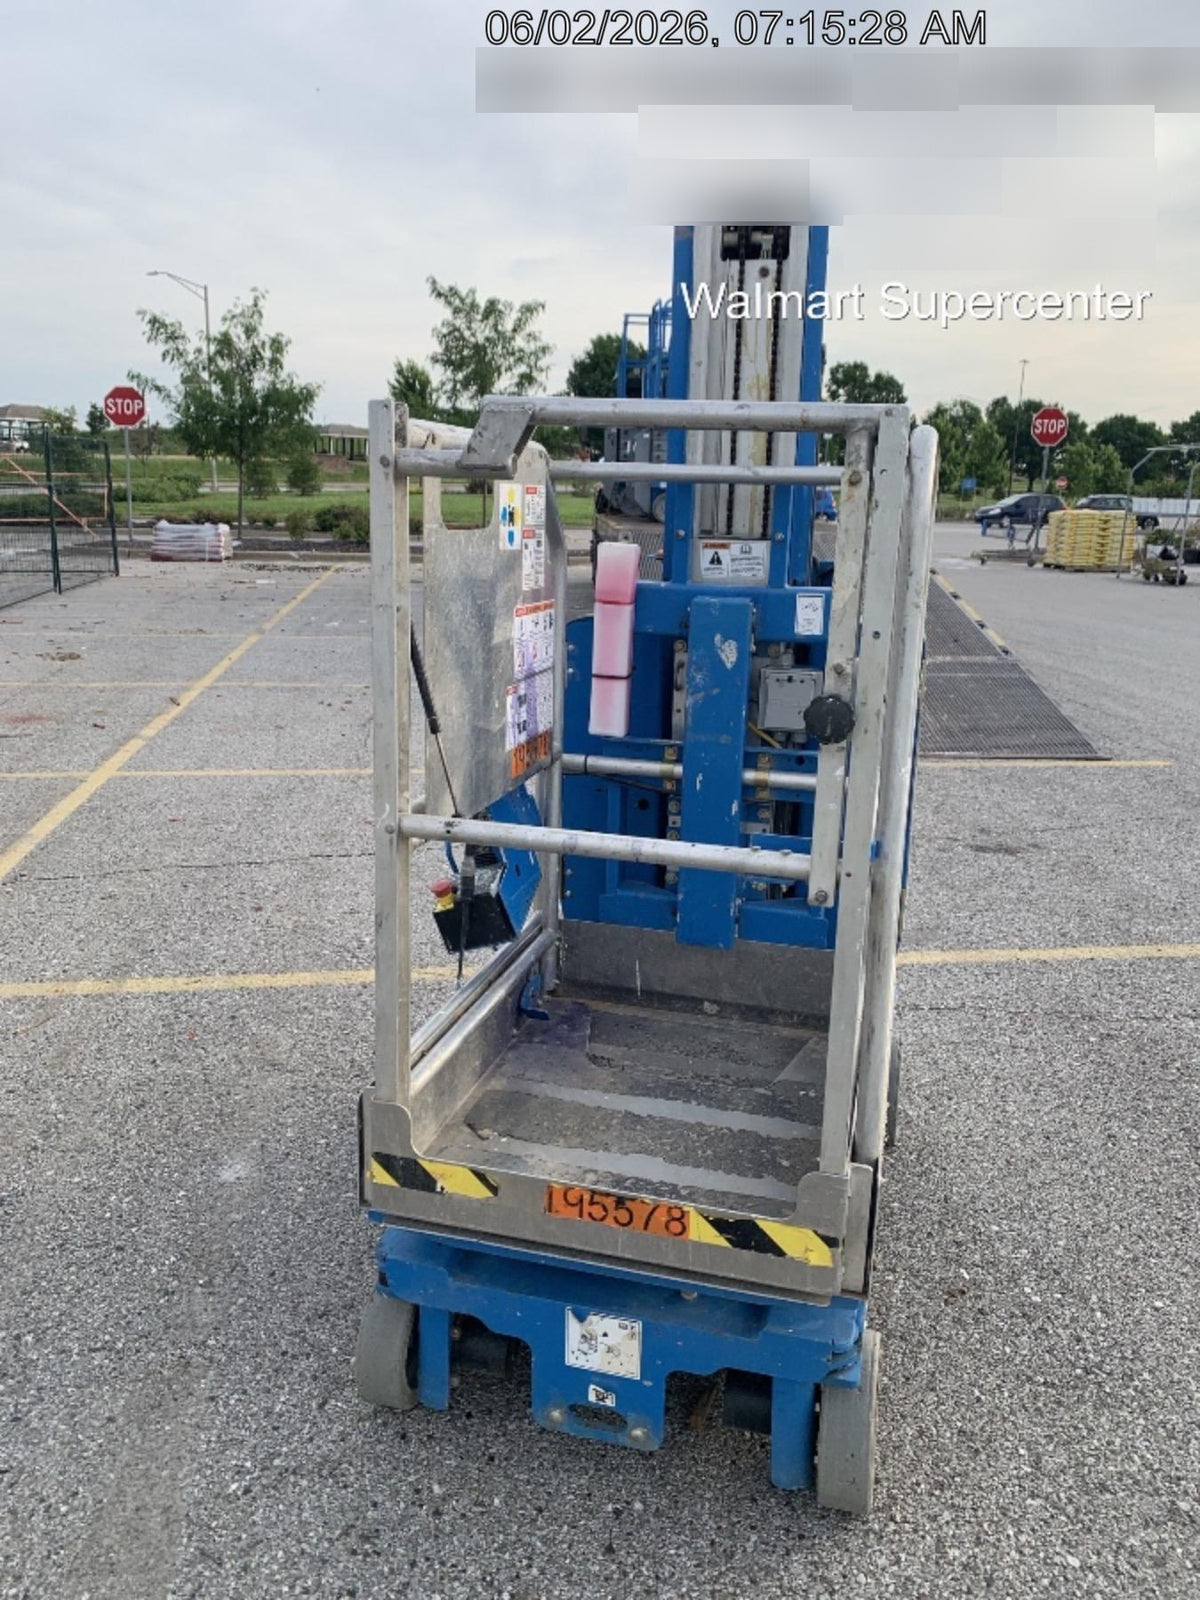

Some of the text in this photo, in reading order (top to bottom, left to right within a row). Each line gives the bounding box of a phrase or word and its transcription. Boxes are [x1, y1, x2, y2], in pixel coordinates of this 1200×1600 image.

[106, 398, 143, 415] STOP
[1034, 418, 1066, 434] STOP
[546, 1185, 687, 1237] 195578
